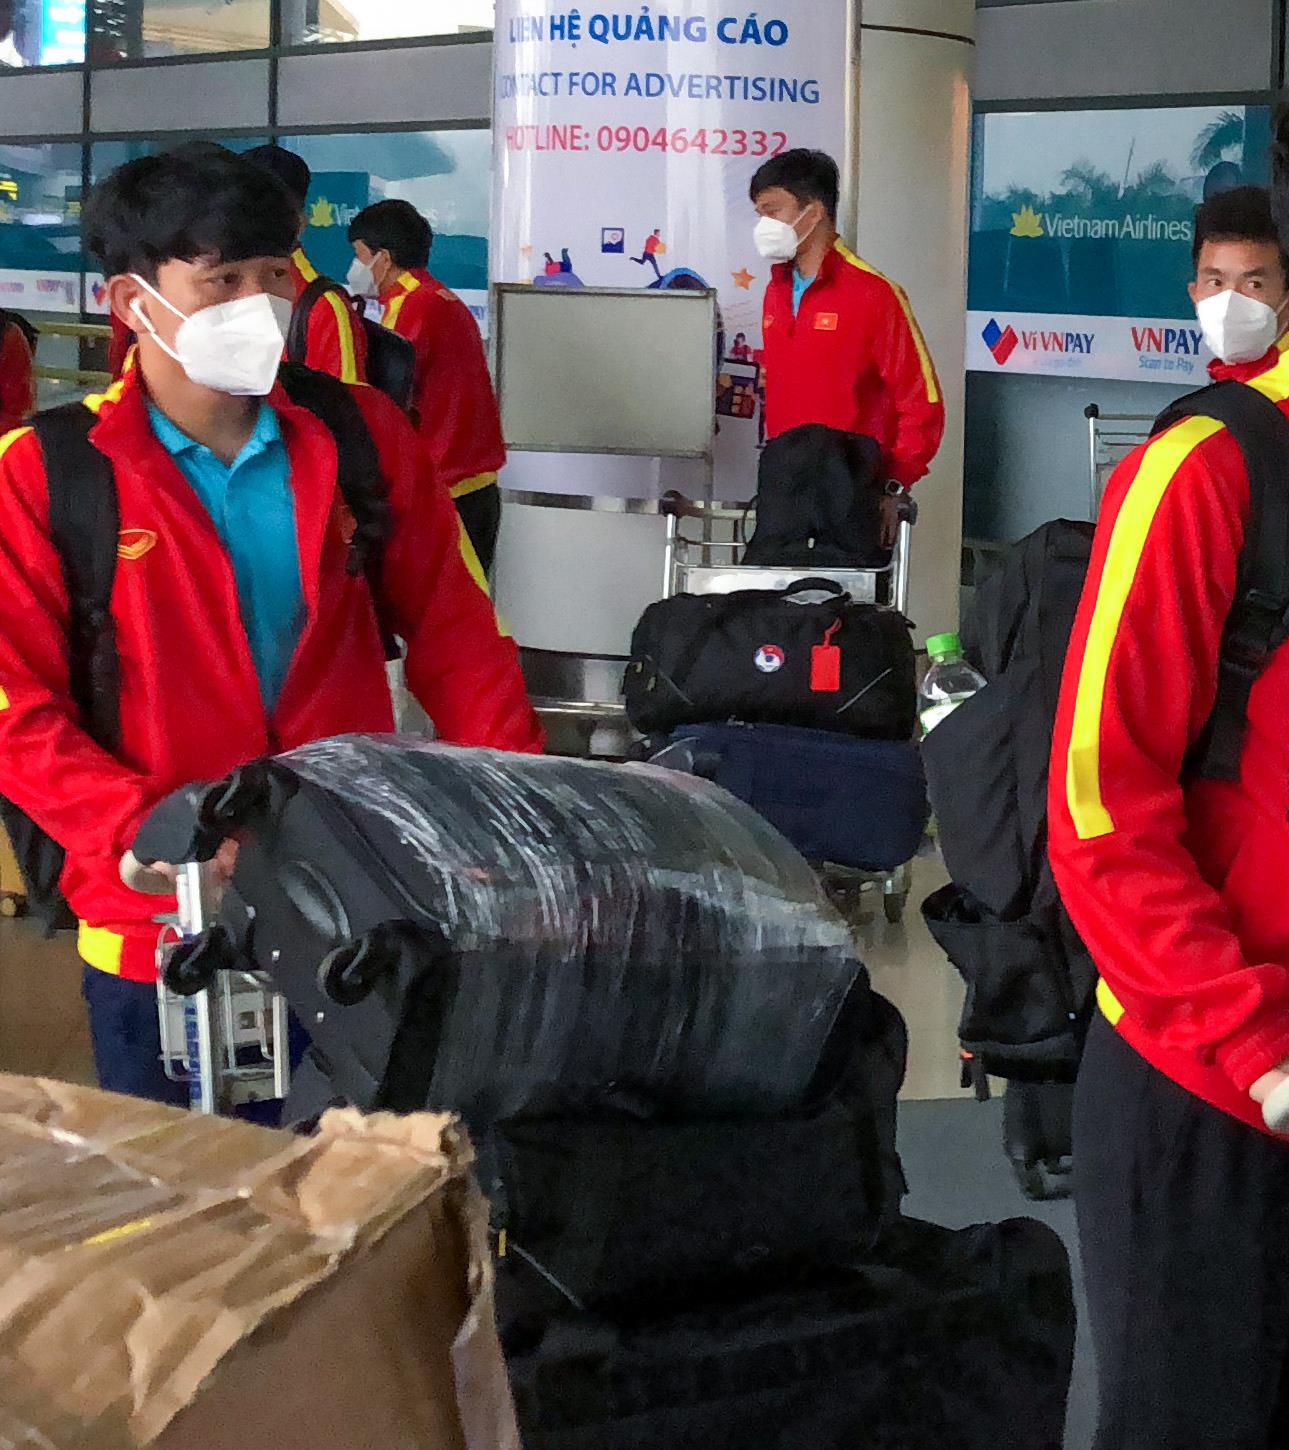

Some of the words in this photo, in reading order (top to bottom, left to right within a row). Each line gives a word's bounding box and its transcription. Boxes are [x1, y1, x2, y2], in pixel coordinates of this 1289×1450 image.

[549, 8, 581, 48] HỆ
[588, 6, 707, 44] QUẢNG
[717, 13, 789, 46] CÁO
[568, 71, 617, 96] FOR
[624, 73, 820, 104] ADVERTISING
[506, 124, 590, 152] HOTLINE:
[597, 126, 788, 157] 0904642332
[1044, 213, 1119, 239] Vietnam
[1120, 213, 1192, 241] Airlines
[1040, 331, 1095, 354] VNPAY
[1131, 326, 1203, 355] VNPAY
